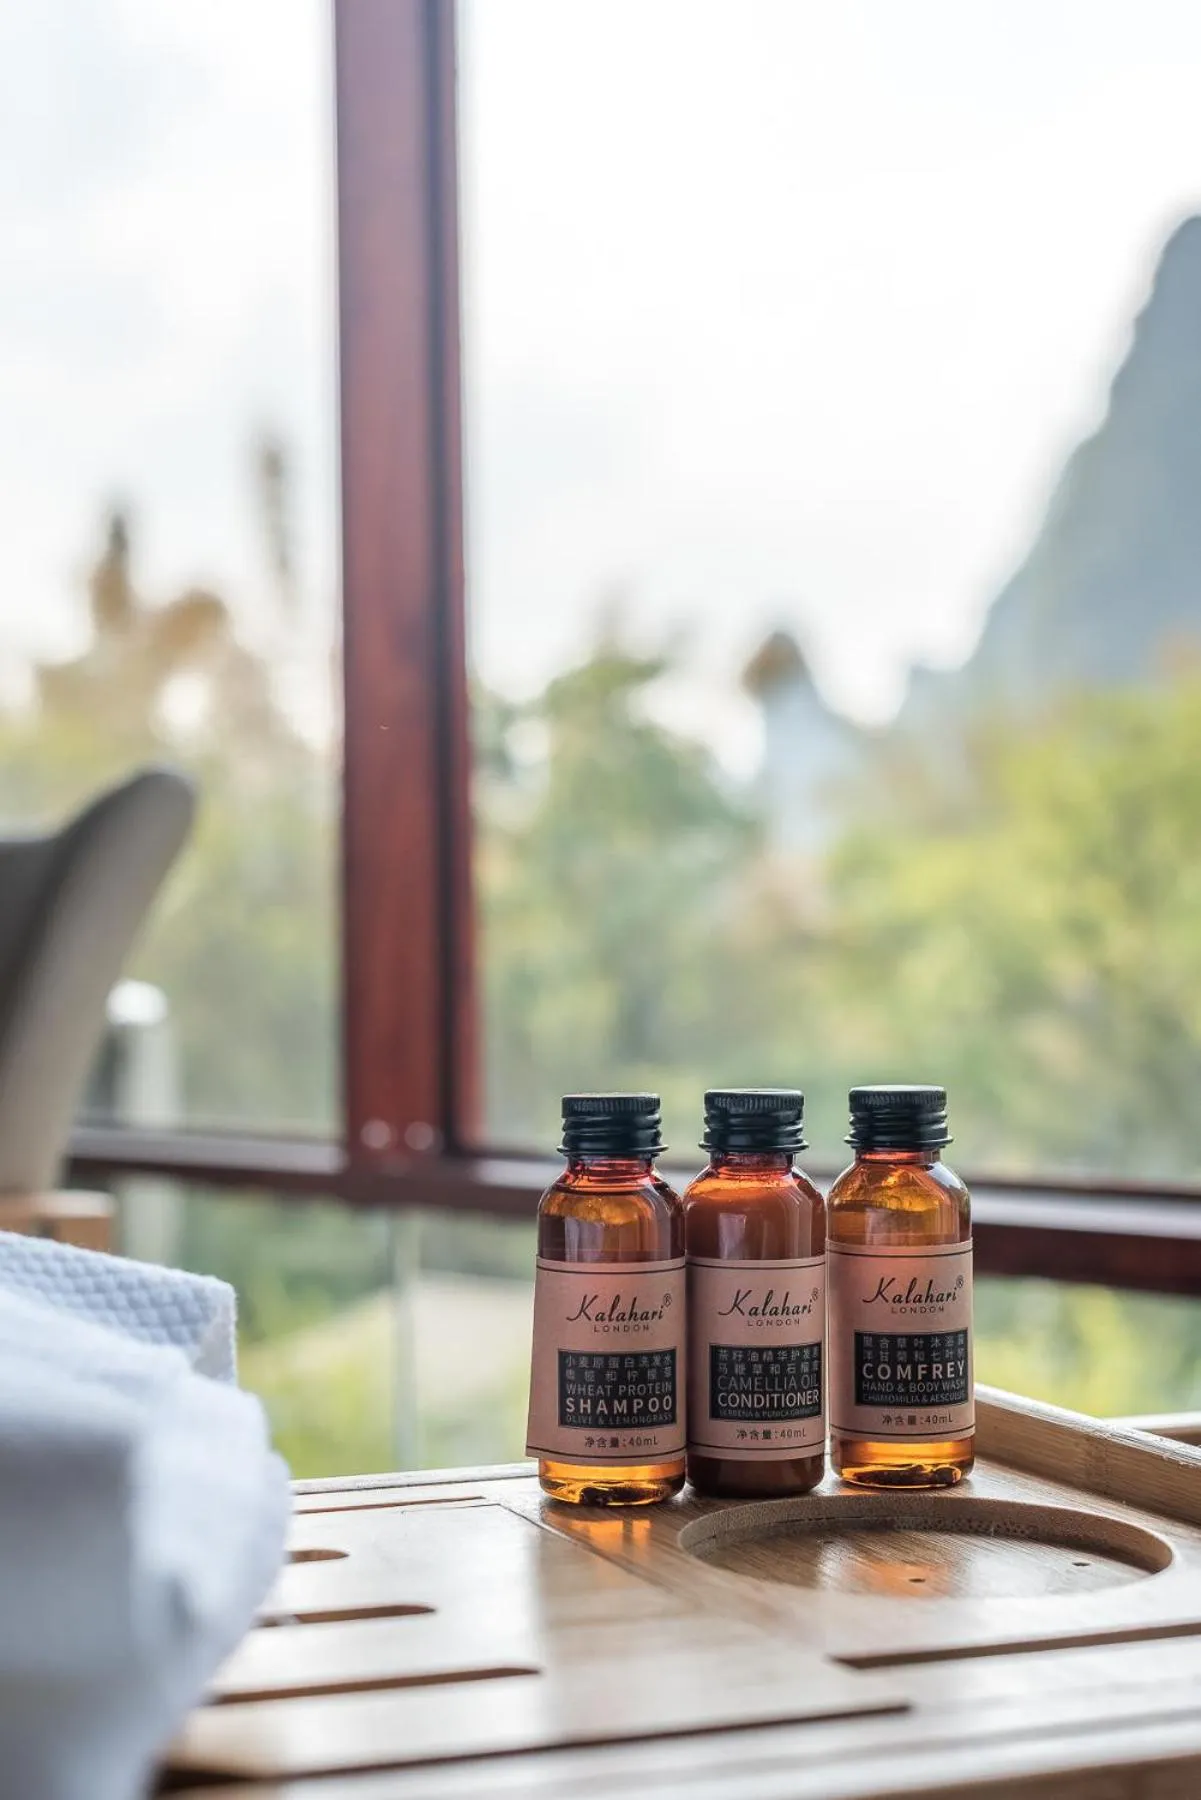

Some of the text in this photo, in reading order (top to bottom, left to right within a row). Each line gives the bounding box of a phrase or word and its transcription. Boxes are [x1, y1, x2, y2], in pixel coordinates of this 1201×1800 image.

[891, 1306, 944, 1314] LONDON
[594, 1324, 650, 1333] LONDON
[747, 1318, 800, 1327] LONDON
[863, 1360, 965, 1380] COMFREY
[566, 1381, 672, 1396] WHEAT PROTEIN
[718, 1373, 818, 1391] CAMELLIA OIL
[862, 1379, 965, 1393] HAND & BODY WASH
[566, 1394, 672, 1414] SHAMPOO
[718, 1389, 819, 1408] CONDITIONER
